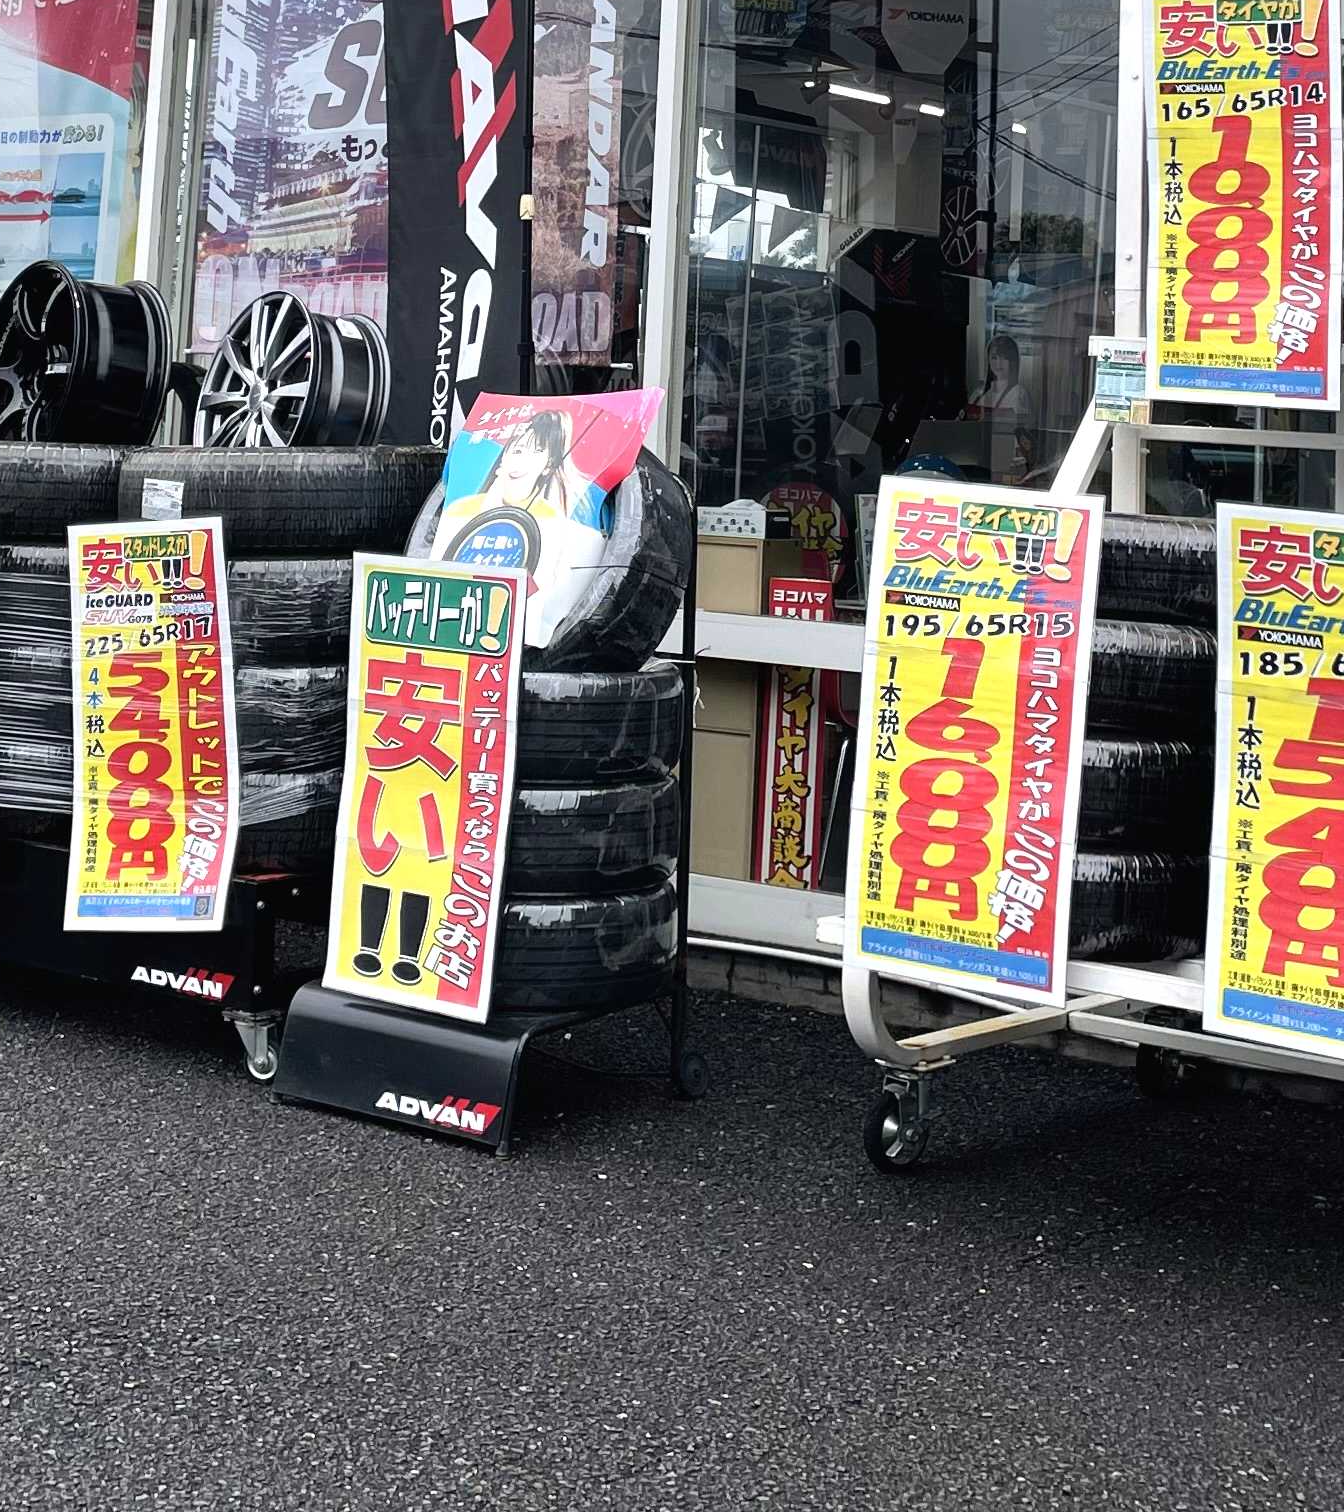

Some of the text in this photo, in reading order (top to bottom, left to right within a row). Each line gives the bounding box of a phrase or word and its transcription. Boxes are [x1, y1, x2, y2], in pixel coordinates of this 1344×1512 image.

[906, 11, 964, 24] YOKOHAMA
[1175, 83, 1224, 94] YOKOHAMA
[1164, 137, 1184, 226] 1本税込
[532, 292, 611, 352] OAD
[963, 502, 1056, 535] タイヤが
[86, 593, 153, 608] iceGUARD
[774, 589, 828, 604] ヨコハマ
[904, 593, 960, 610] YOKOHAMA
[367, 576, 508, 653] バッテリーが!
[1258, 629, 1323, 649] YOKOHAMA
[84, 666, 106, 759] 4本税込
[875, 656, 902, 761] 1本税込
[1236, 696, 1263, 811] 1本税込
[130, 965, 225, 997] ADVAN
[374, 1090, 487, 1132] ADVAN
